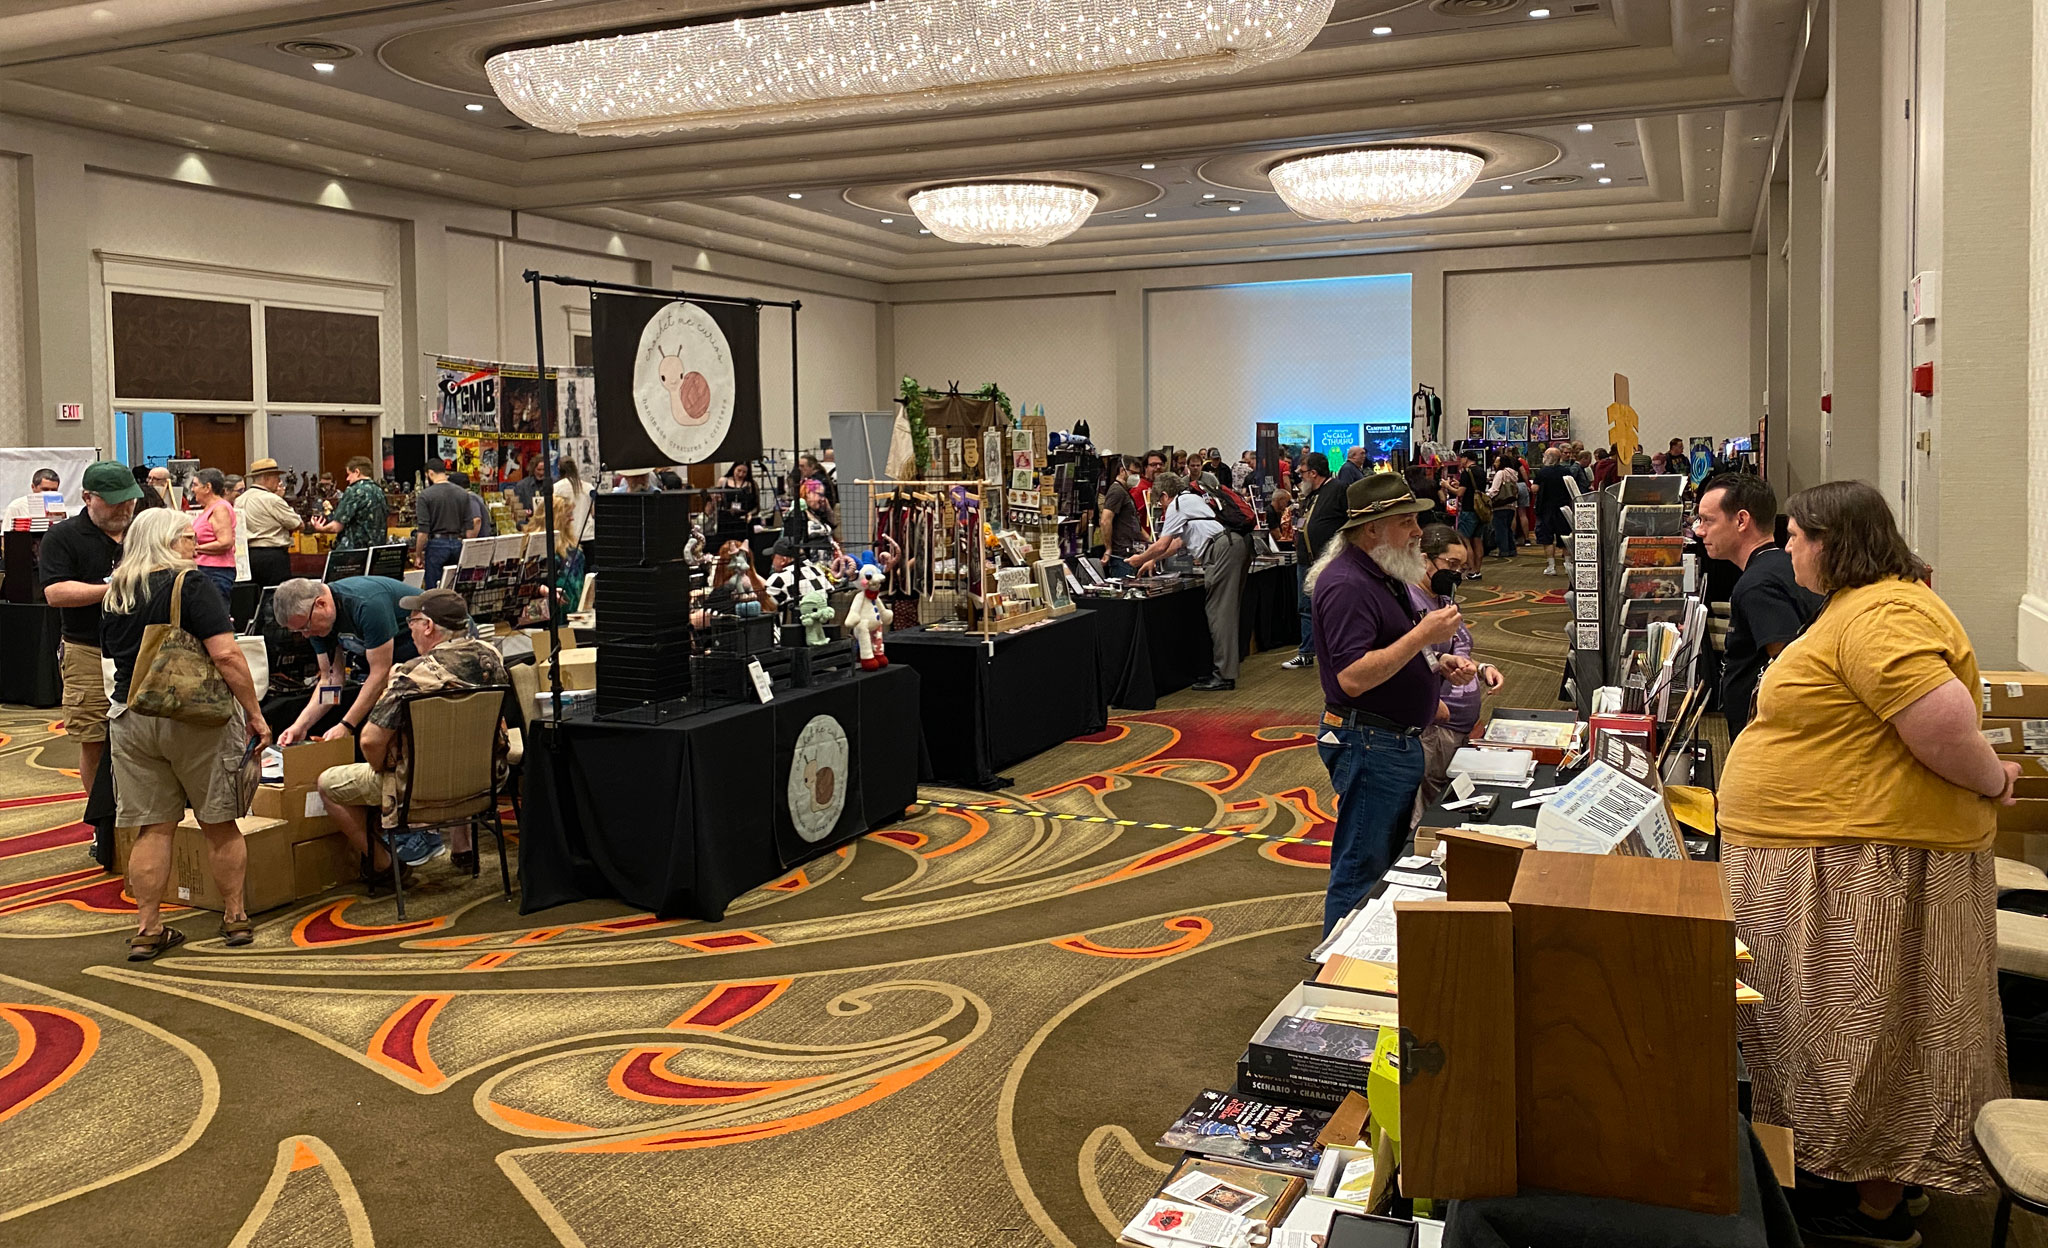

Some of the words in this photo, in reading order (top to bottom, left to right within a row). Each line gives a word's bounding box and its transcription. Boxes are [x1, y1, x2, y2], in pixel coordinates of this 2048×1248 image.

[461, 379, 494, 413] GMB
[62, 404, 80, 418] EXIT
[642, 397, 667, 440] handmade
[1321, 438, 1354, 446] CTHULHU
[1617, 778, 1656, 804] THE
[1597, 789, 1645, 821] SPARK
[1577, 806, 1628, 838] DEVIL
[1252, 1081, 1291, 1094] SCENARIO
[1260, 1106, 1288, 1129] Walker
[1282, 1108, 1304, 1121] The
[1270, 1120, 1293, 1135] Dog
